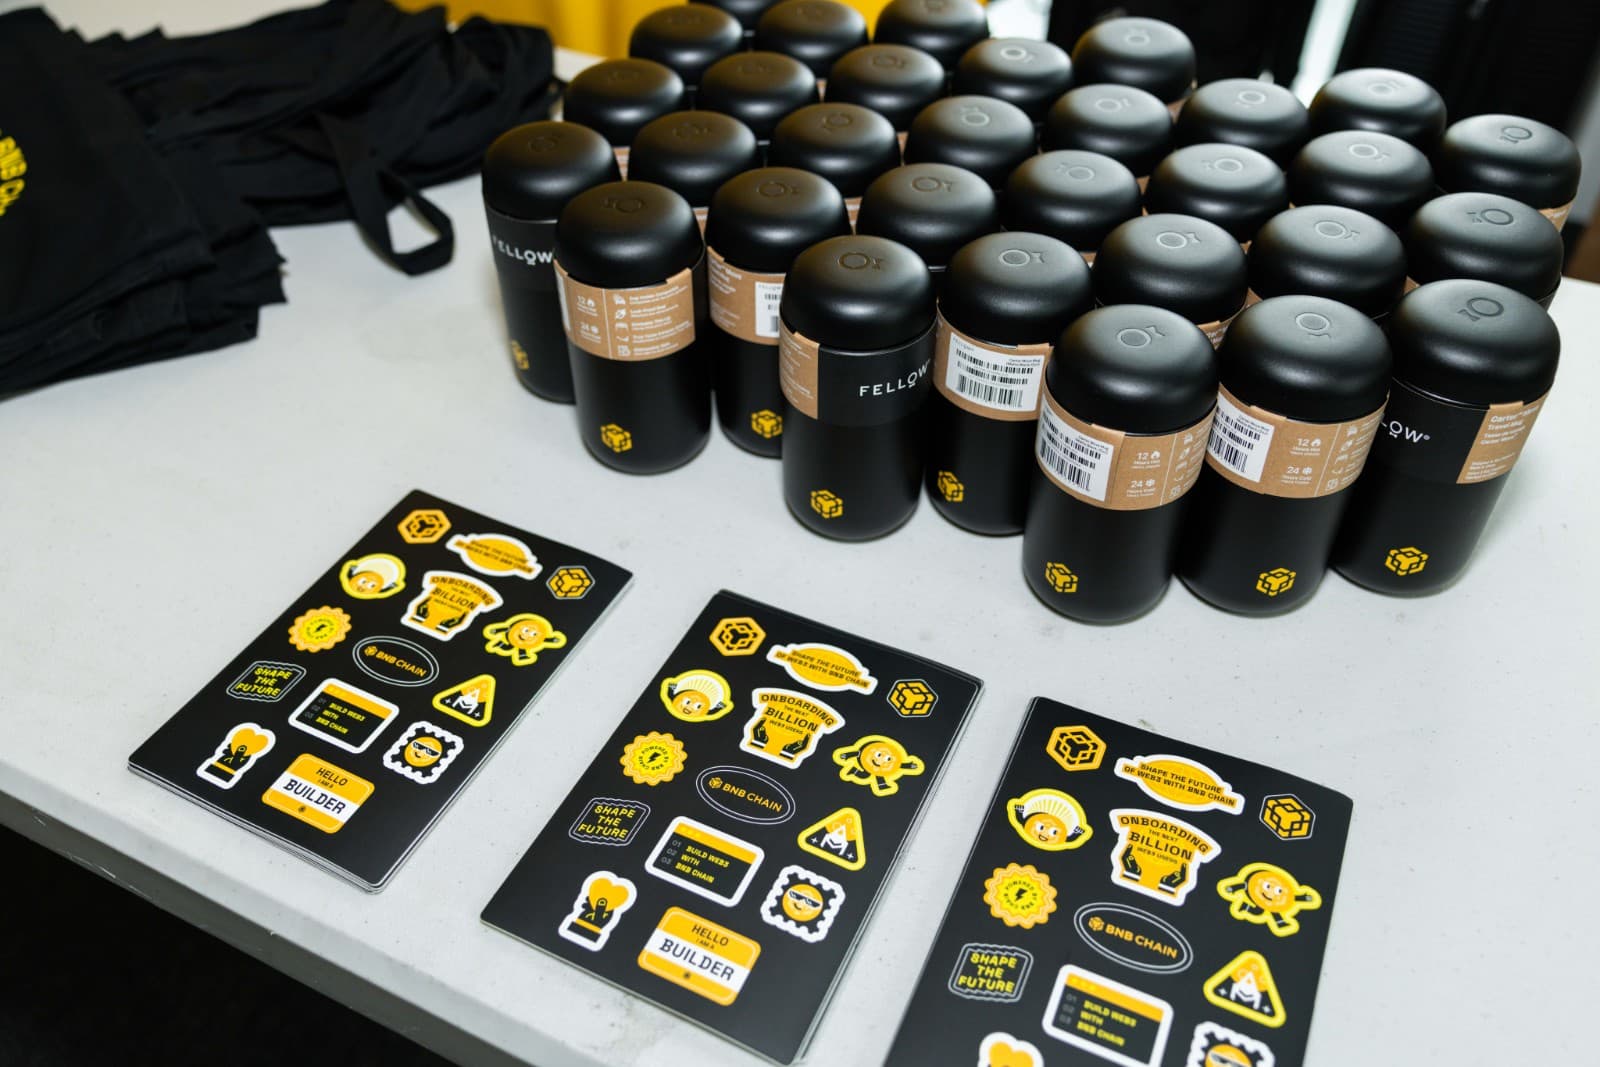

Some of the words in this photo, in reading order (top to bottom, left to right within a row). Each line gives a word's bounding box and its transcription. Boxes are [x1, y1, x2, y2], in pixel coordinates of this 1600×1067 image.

[1297, 438, 1310, 446] 12
[1137, 452, 1148, 460] 12
[1286, 466, 1299, 474] 24
[1130, 480, 1143, 488] 24
[430, 575, 495, 606] ONBOARDING
[432, 587, 478, 611] BILLION
[376, 651, 396, 665] BNB
[395, 659, 427, 677] CHAIN
[791, 650, 816, 664] SHAPE
[816, 660, 831, 668] THE
[831, 663, 862, 677] FUTURE
[254, 667, 293, 680] SHAPE
[255, 676, 276, 686] THE
[809, 663, 828, 673] WITH
[828, 669, 845, 679] BNB
[845, 674, 870, 688] CHAIN
[235, 682, 281, 697] FUTURE
[329, 702, 348, 713] BUILD
[760, 694, 835, 727] ONBOARDING
[764, 706, 819, 732] BILLION
[316, 767, 348, 786] HELLO
[1140, 763, 1168, 777] SHAPE
[1170, 772, 1187, 782] THE
[1187, 777, 1222, 794] FUTURE
[1124, 766, 1136, 774] OF
[1137, 770, 1163, 784] WEB3
[1163, 779, 1186, 790] WITH
[1186, 786, 1206, 797] BNB
[1207, 793, 1235, 807] CHAIN
[283, 779, 346, 815] BUILDER
[722, 783, 746, 798] BNB
[746, 793, 783, 813] CHAIN
[594, 805, 636, 819] SHAPE
[597, 815, 622, 827] THE
[578, 823, 628, 838] FUTURE
[1120, 816, 1209, 854] ONBOARDING
[1149, 829, 1160, 837] THE
[1161, 833, 1179, 842] NEXT
[666, 848, 678, 856] 02
[671, 839, 682, 848] 01
[686, 845, 708, 859] BUILD
[1129, 831, 1193, 860] BILLION
[661, 856, 672, 865] 03
[680, 854, 700, 866] WITH
[675, 862, 692, 874] BNB
[691, 869, 715, 884] CHAIN
[691, 924, 729, 946] HELLO
[1105, 923, 1133, 942] BNB
[1134, 934, 1178, 959] CHAIN
[659, 938, 735, 982] BUILDER
[970, 952, 1018, 968] SHAPE
[977, 965, 1004, 979] THE
[958, 975, 1015, 993] FUTURE
[1083, 999, 1110, 1016] BUILD
[1080, 1010, 1104, 1026] WITH
[1076, 1020, 1097, 1035] BNB
[1097, 1028, 1125, 1047] CHAIN
